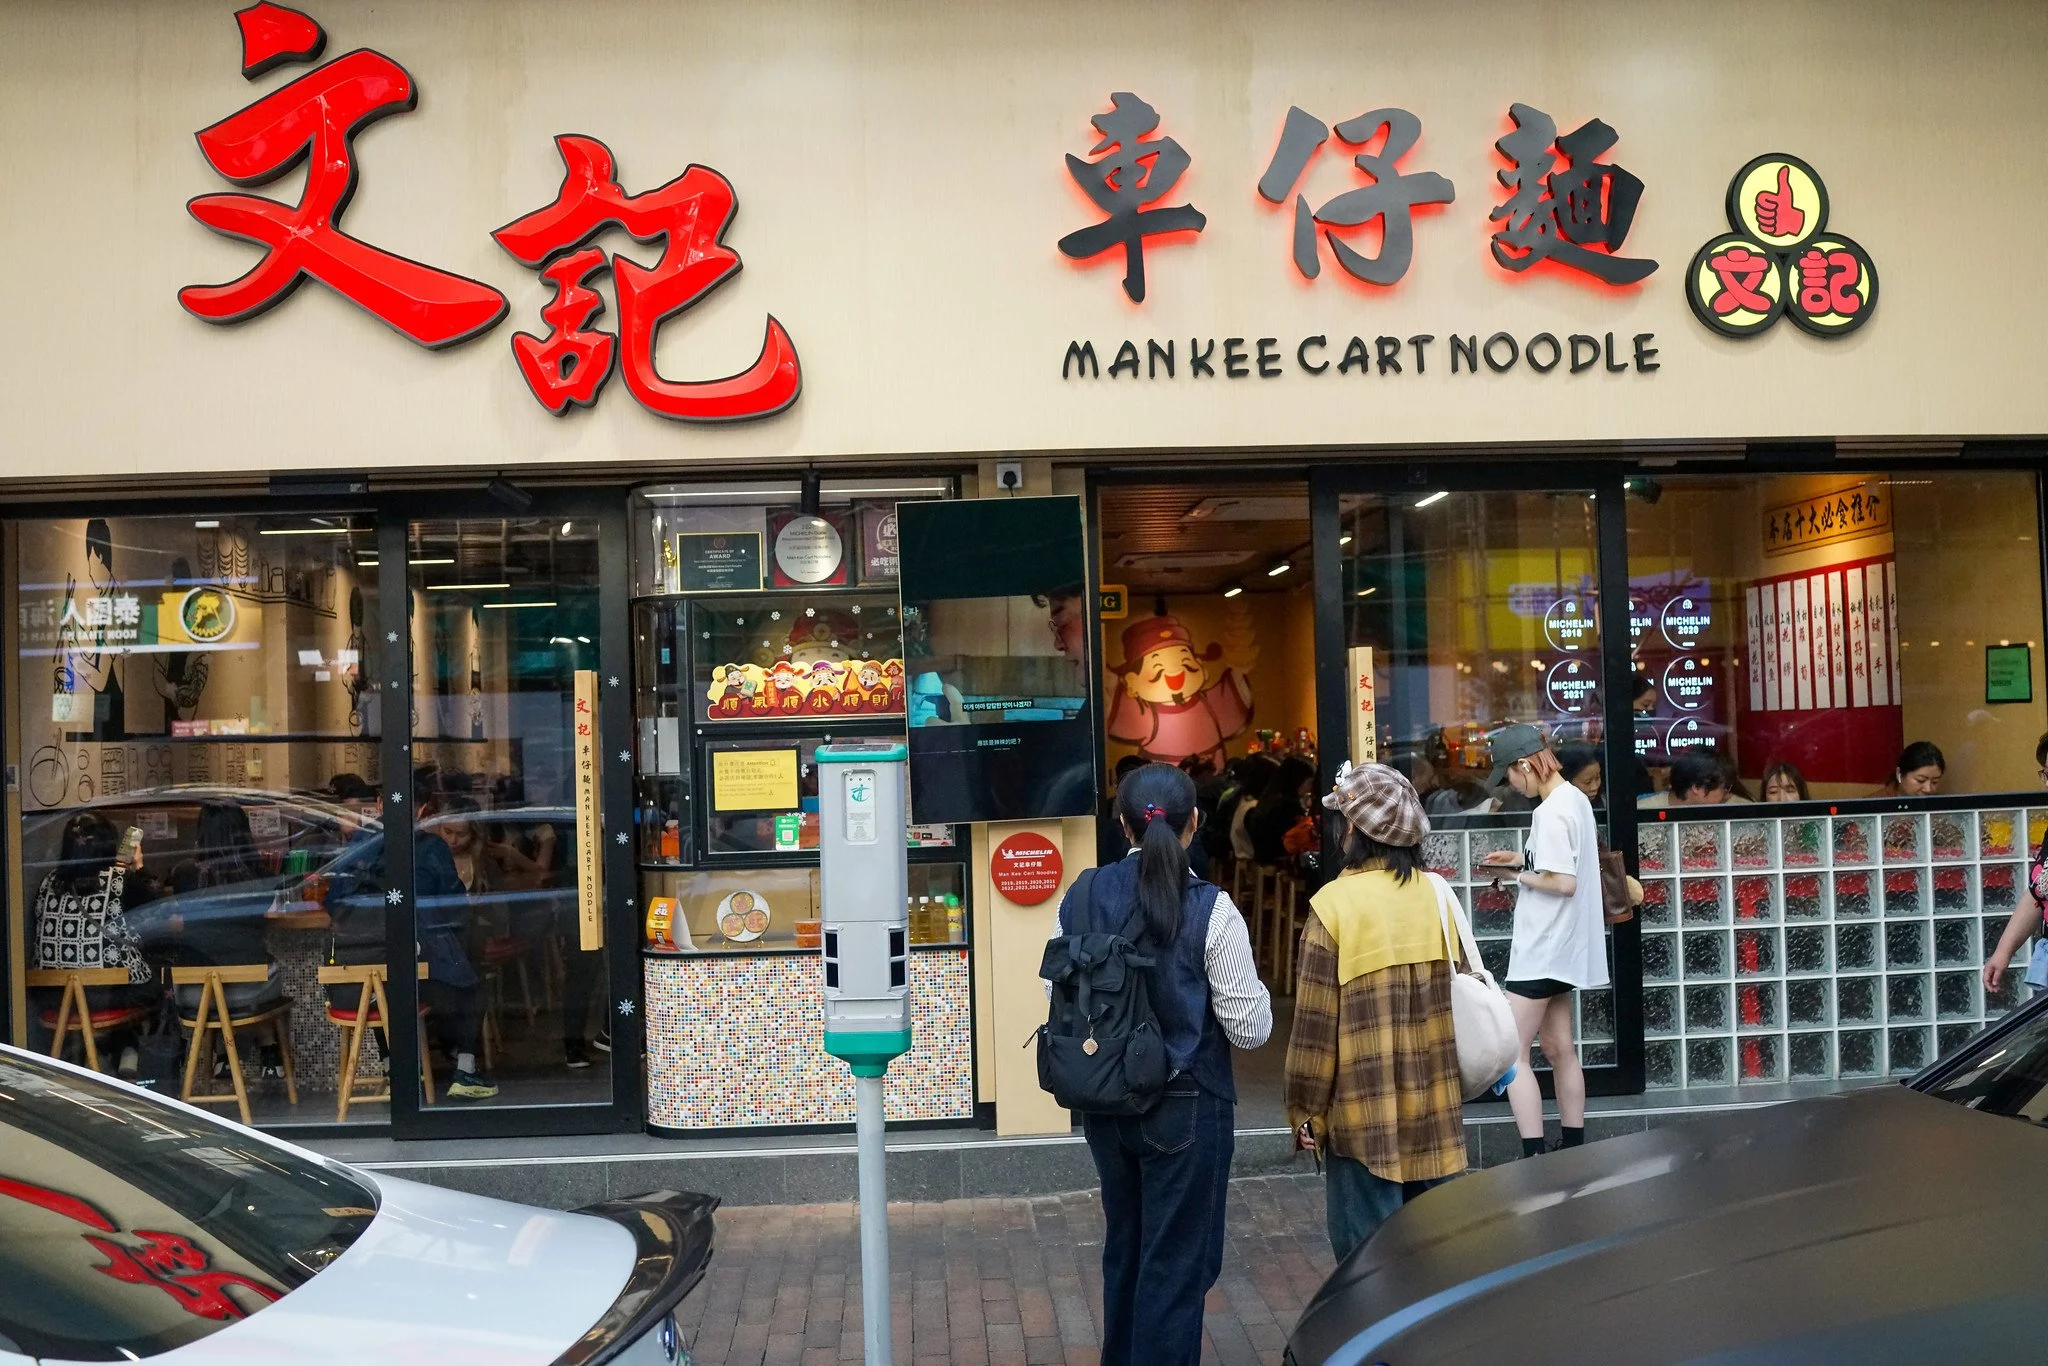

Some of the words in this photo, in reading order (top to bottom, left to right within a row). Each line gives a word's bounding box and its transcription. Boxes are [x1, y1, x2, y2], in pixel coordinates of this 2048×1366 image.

[1057, 91, 1659, 304] 車仔麵
[178, 1, 800, 422] 文記
[1708, 247, 1862, 316] 文記
[1062, 338, 1175, 380] MAN
[1190, 337, 1283, 378] KEE
[1297, 334, 1436, 376] CART
[1449, 331, 1660, 375] NOODLE
[1549, 618, 1594, 628] MICHELIN
[1630, 617, 1651, 627] ELIN
[1665, 616, 1711, 626] MICHELIN
[1630, 627, 1641, 636] 19
[1678, 625, 1699, 635] 2020
[1551, 680, 1596, 690] MICHELIN
[1668, 676, 1713, 687] MICHELIN
[1563, 690, 1584, 699] 2021
[1680, 686, 1702, 696] 2023
[1635, 739, 1657, 748] ELIN
